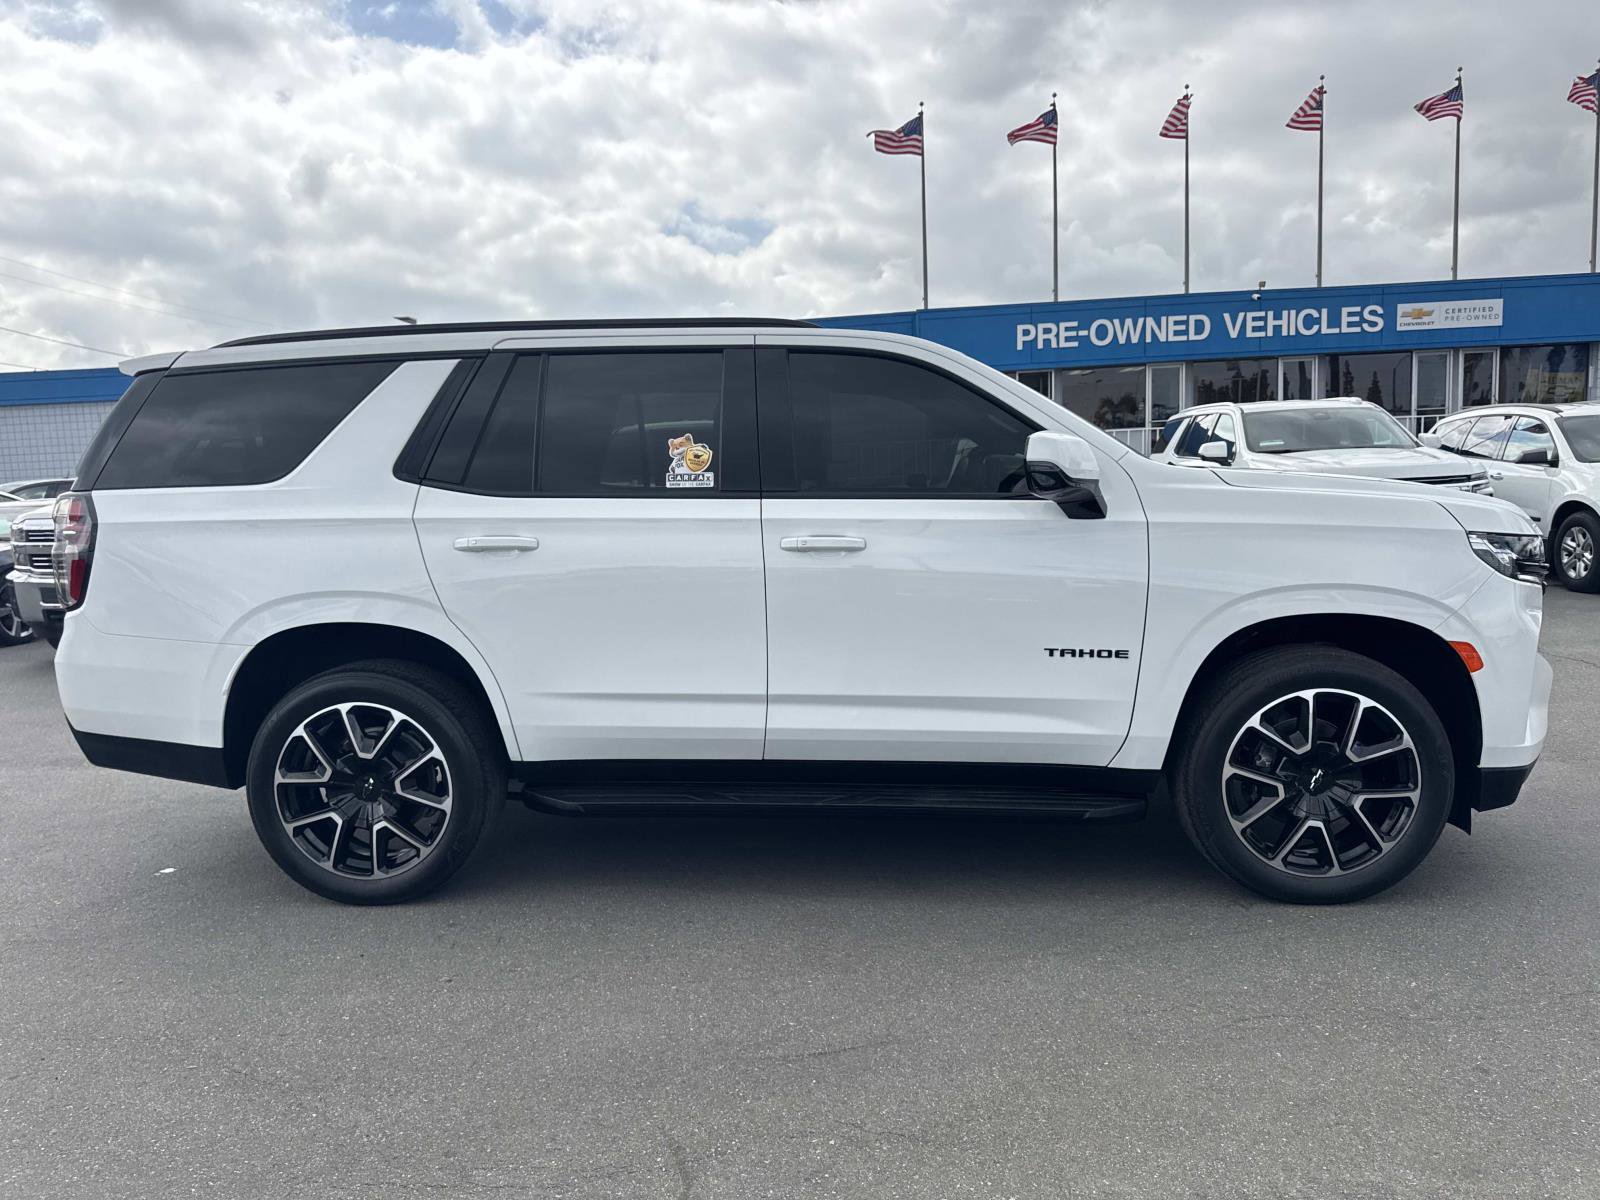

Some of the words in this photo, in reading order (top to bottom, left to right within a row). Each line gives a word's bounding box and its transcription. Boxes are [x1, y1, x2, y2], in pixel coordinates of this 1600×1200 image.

[1445, 306, 1494, 314] CERTIFIED
[1444, 313, 1500, 321] PRE-OWNED
[1016, 314, 1211, 350] PRE-OWNED
[1223, 304, 1384, 339] VEHICLES
[1044, 648, 1129, 659] TAHOE
